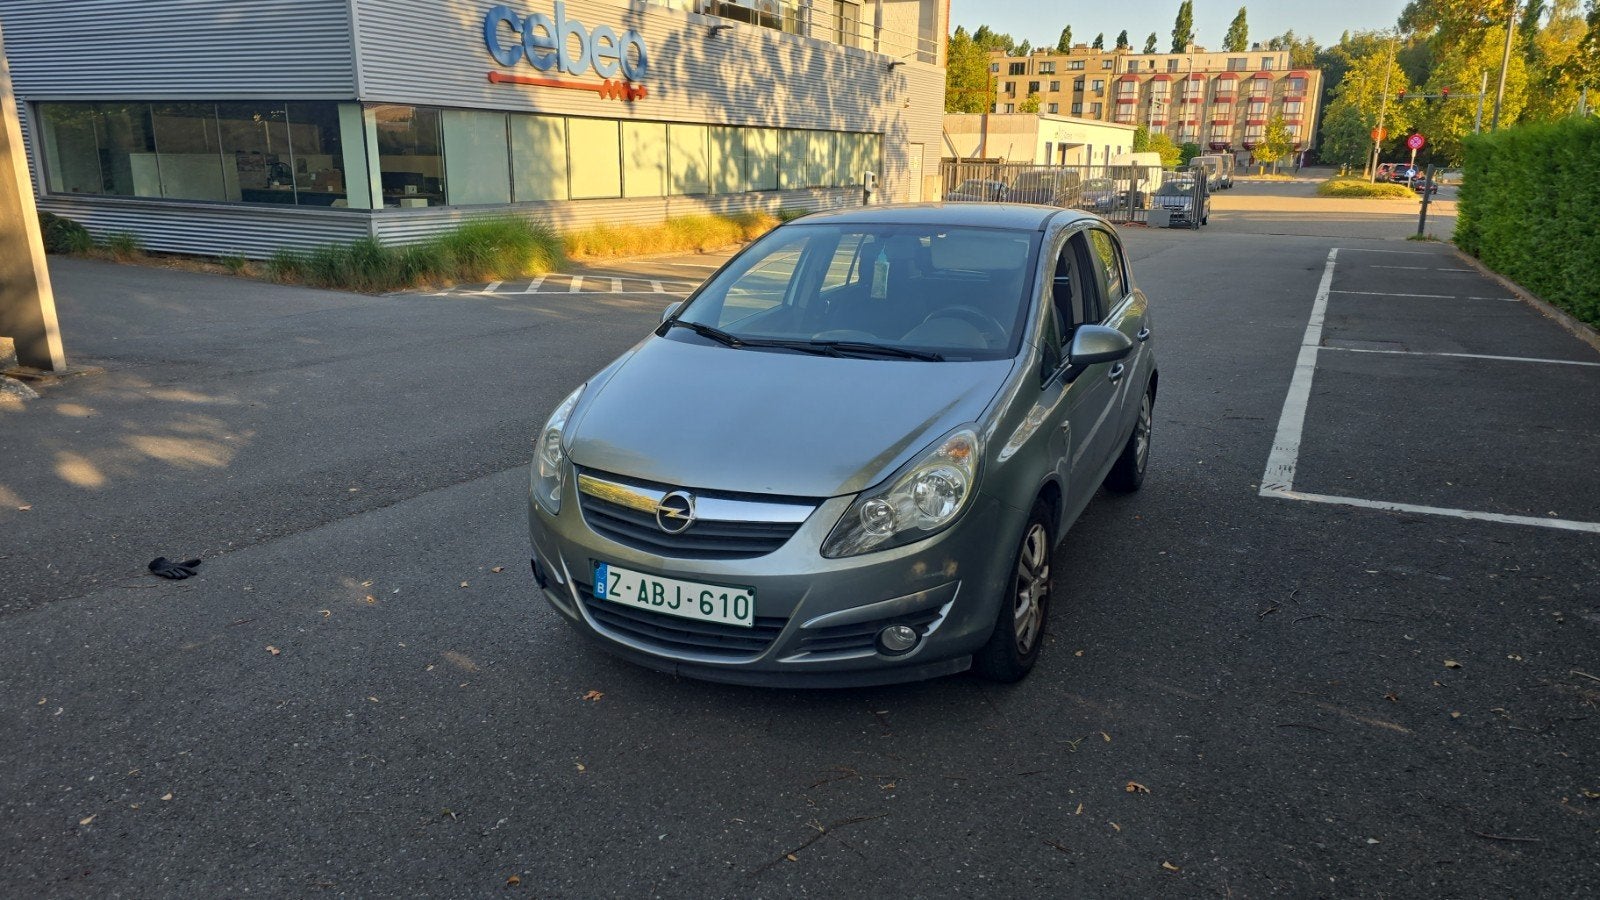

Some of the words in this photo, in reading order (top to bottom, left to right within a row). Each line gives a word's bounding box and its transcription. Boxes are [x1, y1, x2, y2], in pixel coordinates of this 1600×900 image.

[483, 0, 648, 81] cebeo
[597, 582, 604, 593] B
[609, 571, 749, 620] Z-ABJ-610
